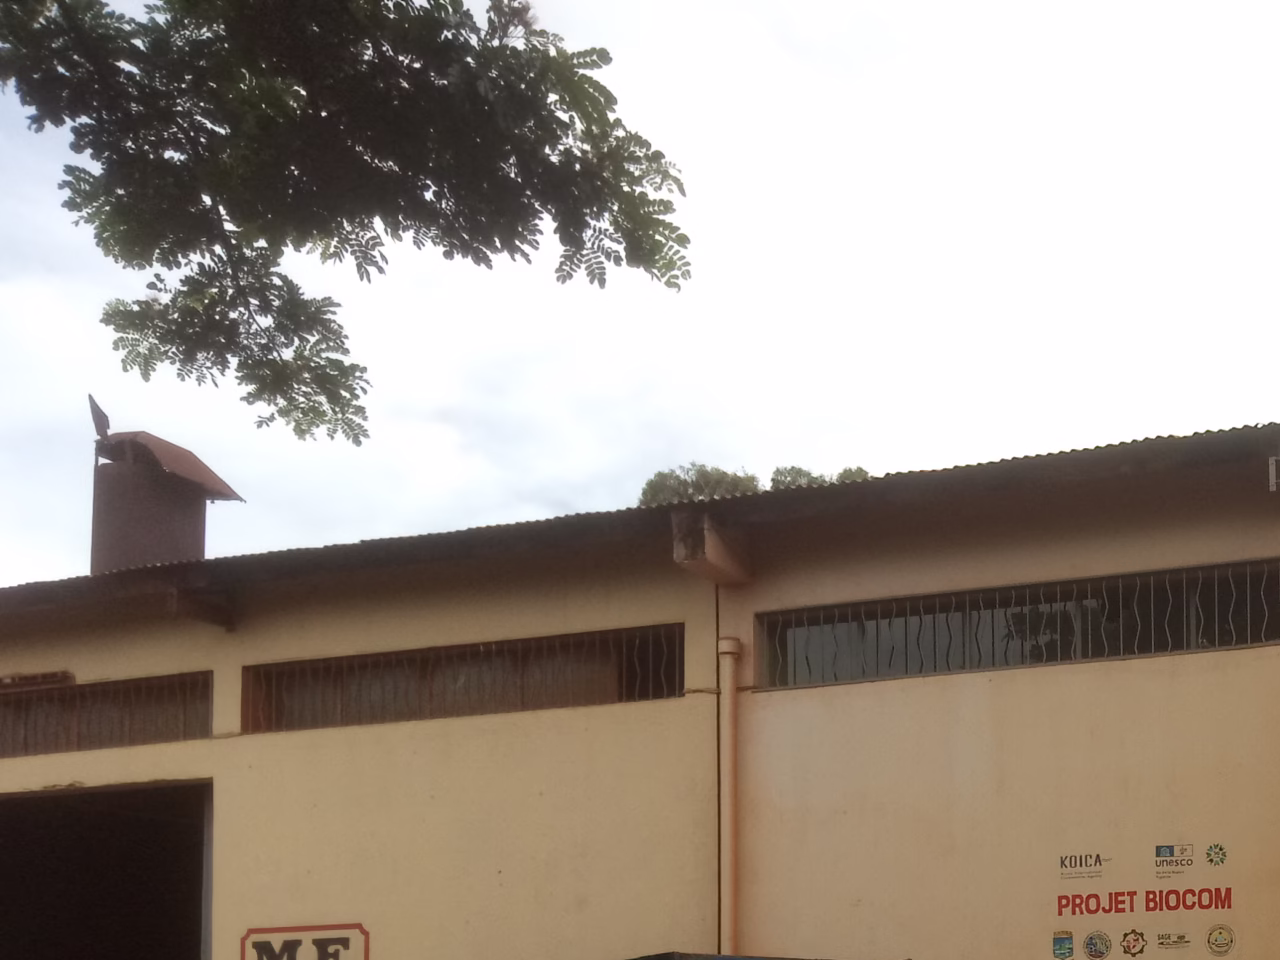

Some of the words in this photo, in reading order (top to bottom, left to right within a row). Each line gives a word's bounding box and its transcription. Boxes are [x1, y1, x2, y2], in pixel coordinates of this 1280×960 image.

[1060, 853, 1102, 869] KOICA
[1155, 858, 1193, 868] unesco
[1057, 890, 1137, 916] PROJET
[1145, 887, 1232, 912] BIOCOM
